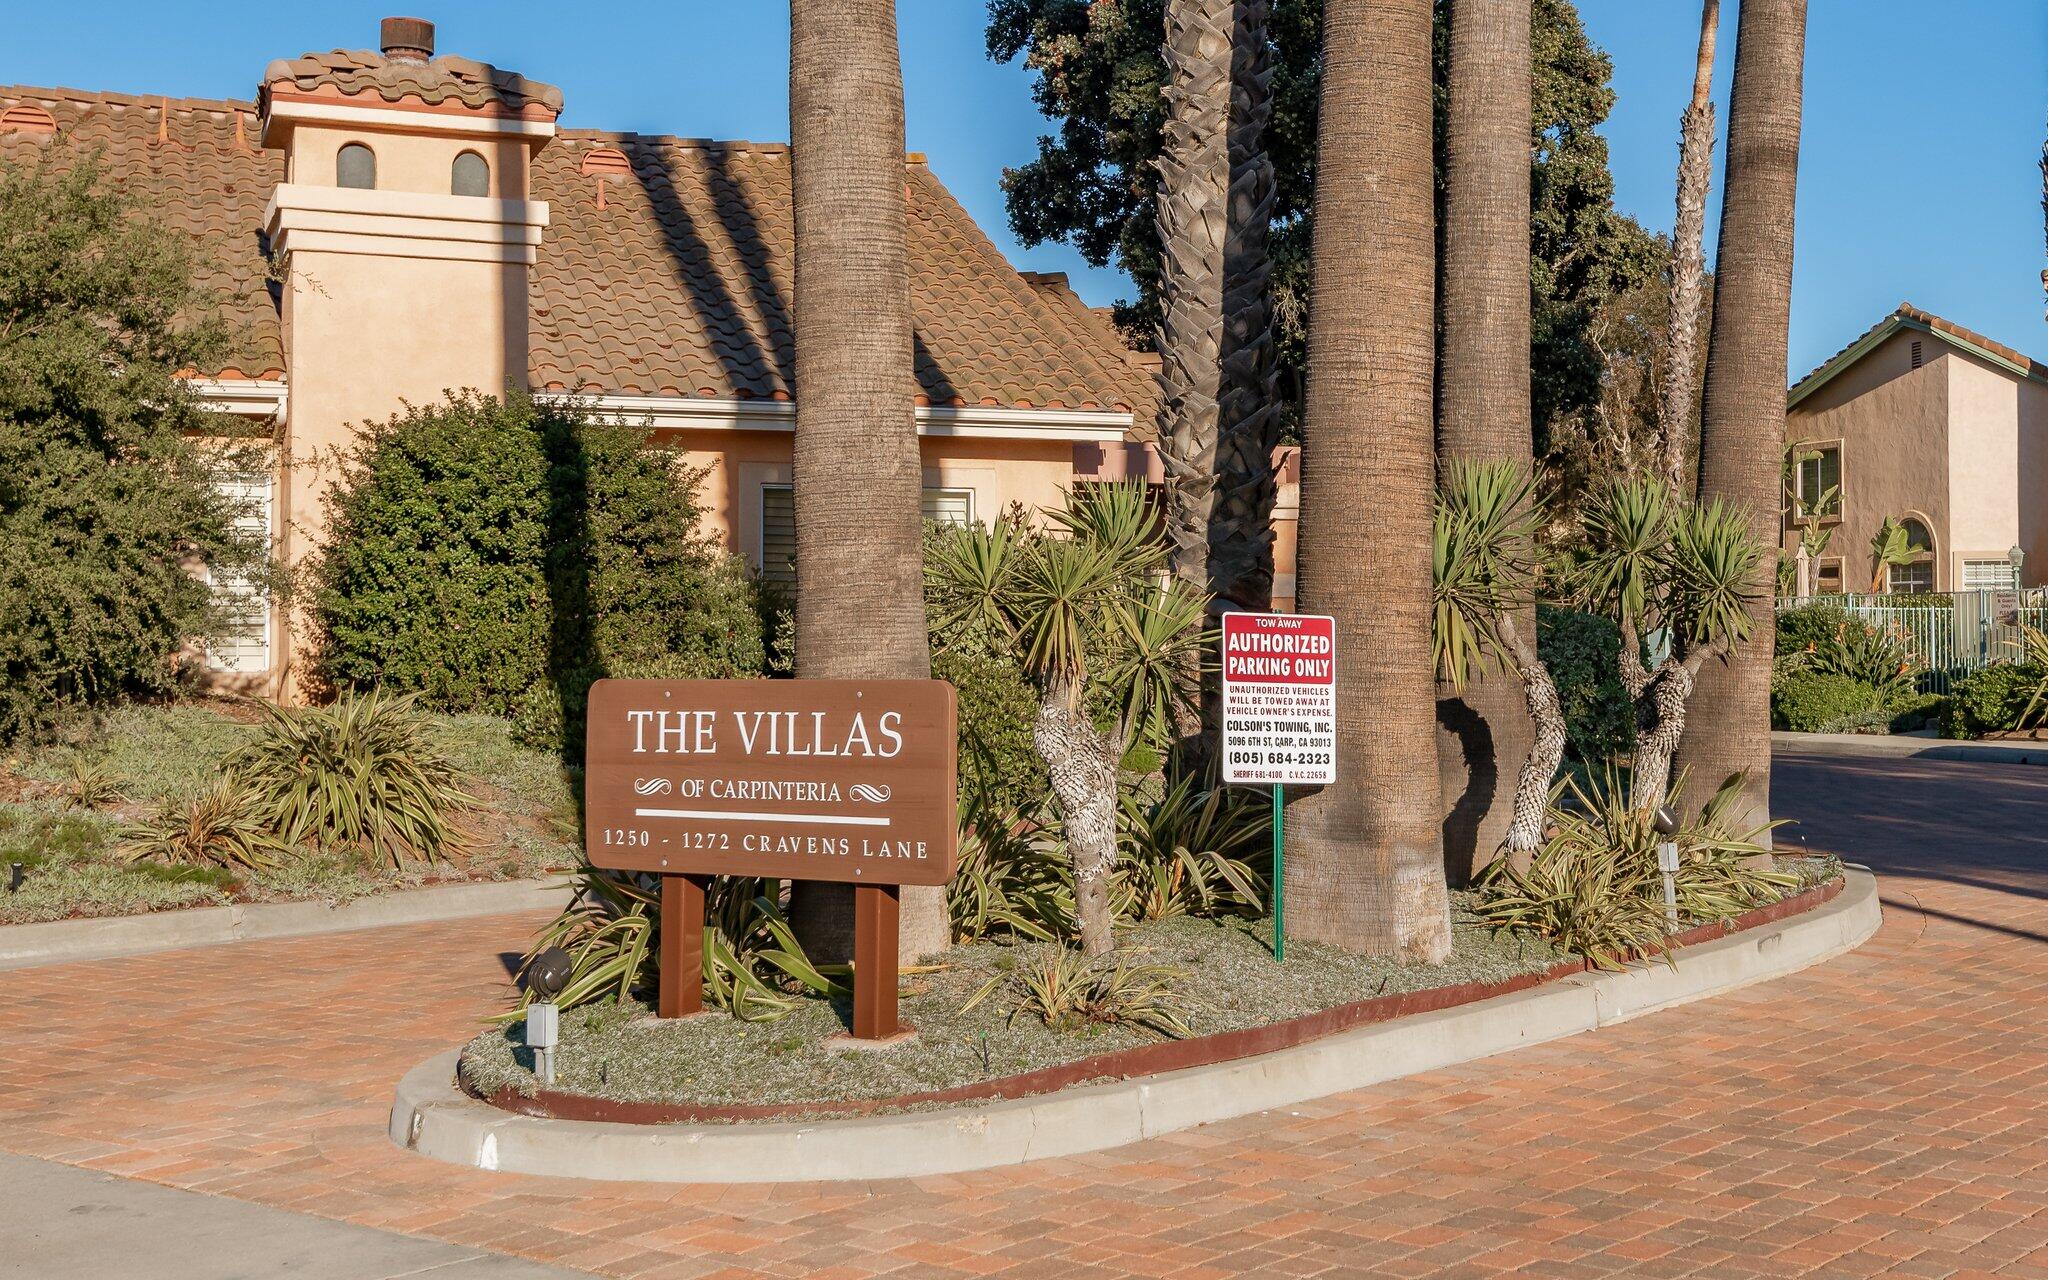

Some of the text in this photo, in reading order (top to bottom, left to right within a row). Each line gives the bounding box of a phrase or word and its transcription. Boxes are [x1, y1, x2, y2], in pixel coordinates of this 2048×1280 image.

[1256, 618, 1302, 628] TOW AWAY
[1229, 633, 1330, 653] AUTHORIZED
[1229, 657, 1330, 677] PARKING ONLY
[1230, 686, 1290, 694] UNAUTHORIZED
[1227, 707, 1257, 715] VEHICLE
[627, 710, 902, 758] THE VILLAS
[1227, 721, 1332, 734] COLSON'S TOWING, INC.
[1228, 737, 1246, 746] 5096
[1248, 737, 1260, 746] 6TH
[1263, 737, 1273, 748] ST,
[1299, 738, 1308, 747] CA
[1310, 738, 1331, 747] 93013
[1229, 752, 1330, 765] (805) 684-2323
[682, 779, 841, 802] OF CARPINTERIA
[604, 829, 649, 847] 1250
[682, 832, 730, 850] 1272
[743, 835, 849, 855] CRAVENS
[863, 841, 927, 859] LANE
